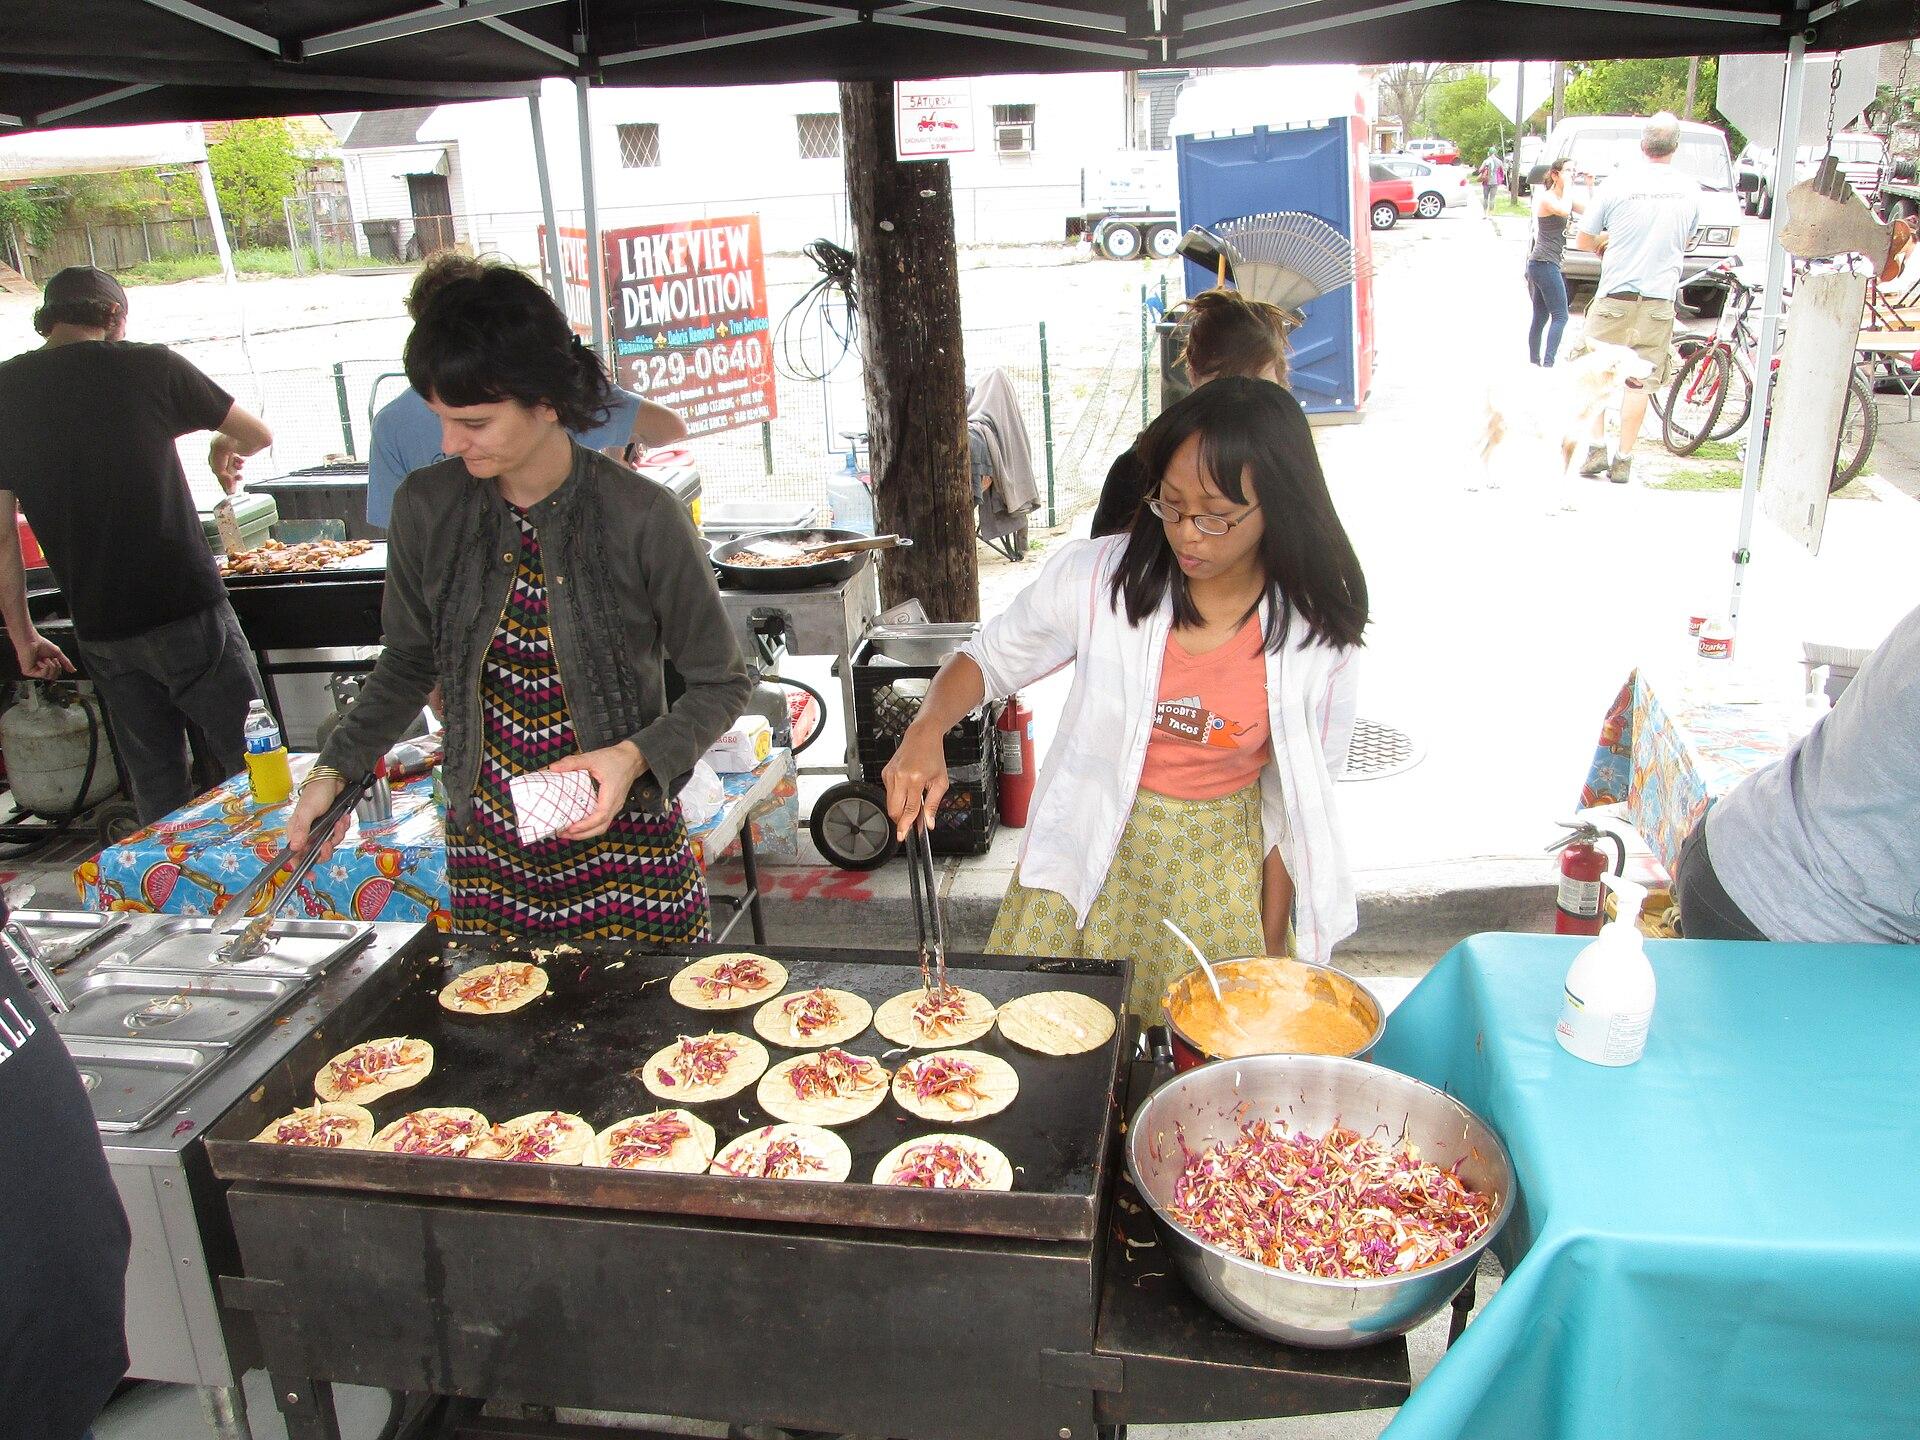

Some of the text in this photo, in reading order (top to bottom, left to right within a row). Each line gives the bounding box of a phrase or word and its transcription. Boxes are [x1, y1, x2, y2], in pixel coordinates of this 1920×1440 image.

[617, 224, 750, 282] LAKEVIEW
[621, 269, 755, 329] DEMOLITION
[668, 328, 688, 346] Debris
[689, 323, 715, 343] Removal
[727, 319, 744, 335] Tree
[744, 316, 769, 333] Services
[631, 338, 762, 393] 329-0640
[1699, 642, 1727, 651] Ozarka
[1168, 717, 1199, 735] TACOS
